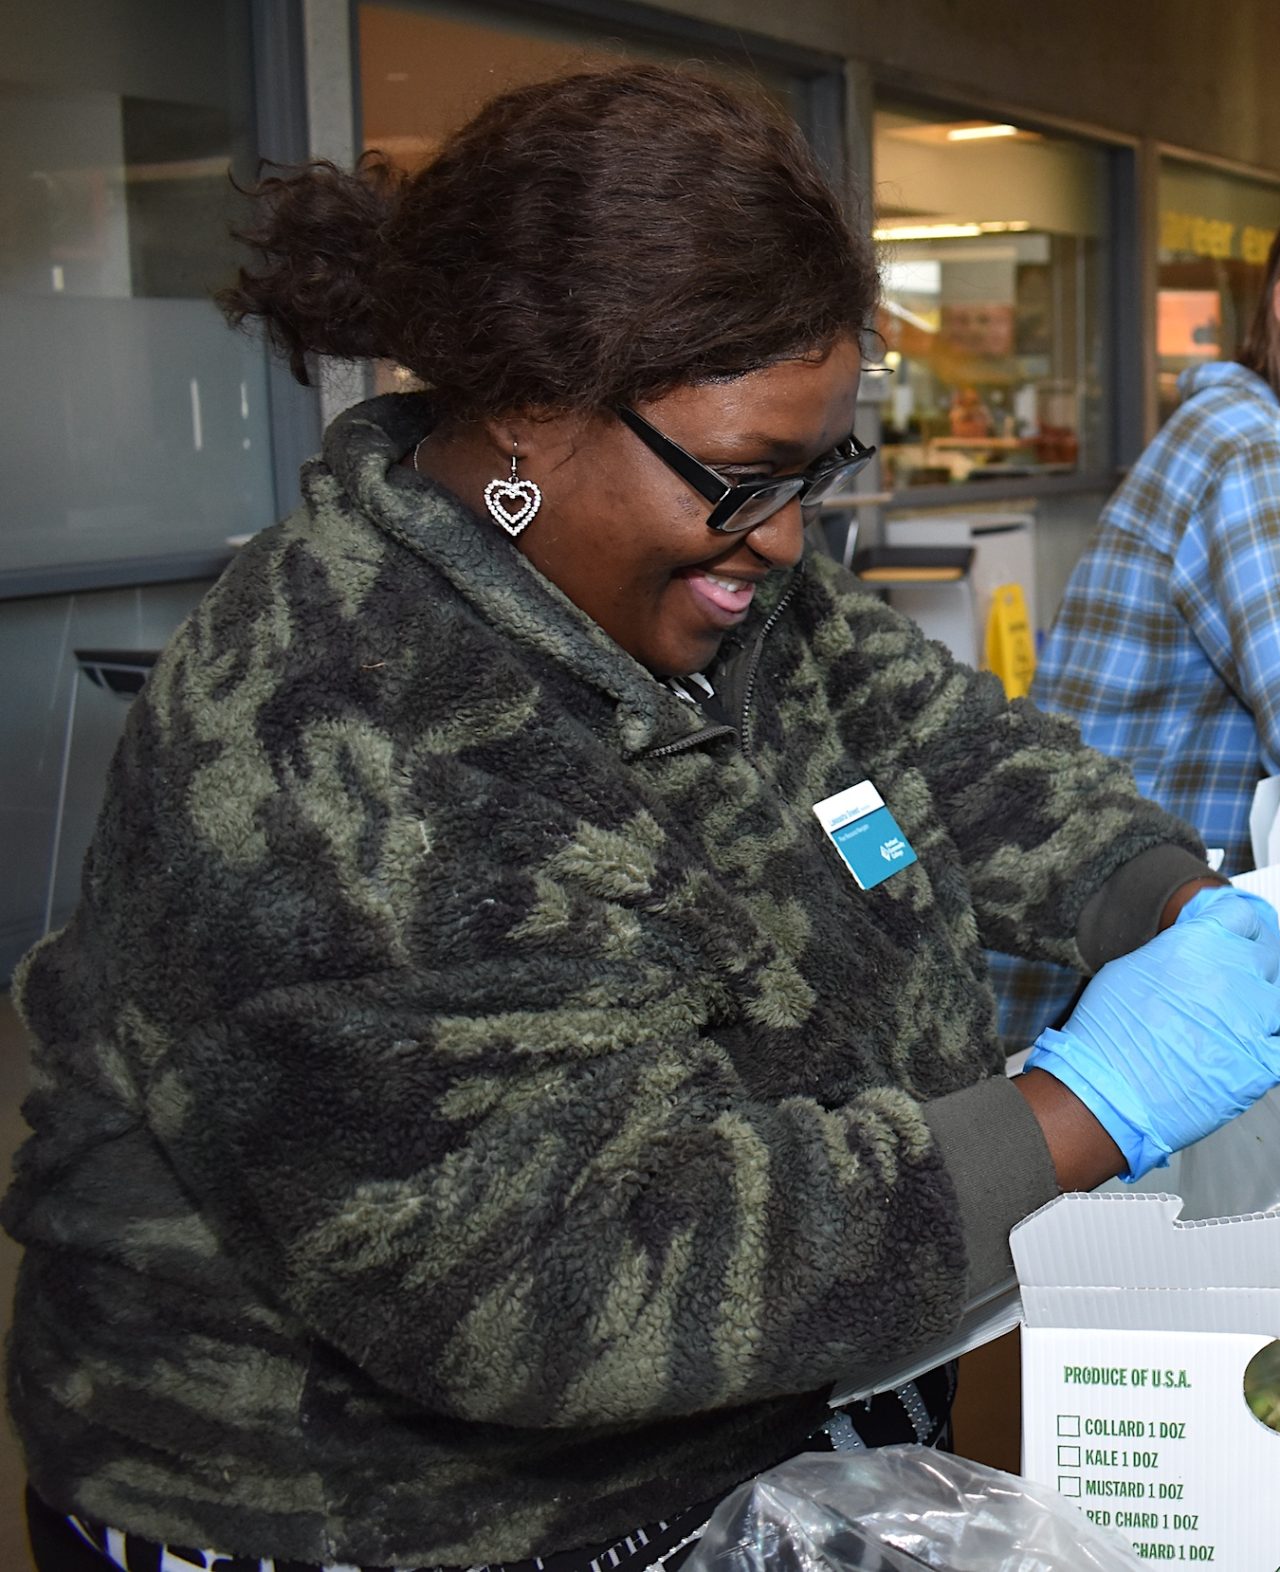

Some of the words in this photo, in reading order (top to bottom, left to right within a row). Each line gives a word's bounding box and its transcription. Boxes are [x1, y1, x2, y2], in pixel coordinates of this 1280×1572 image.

[1064, 1366, 1127, 1386] PRODUCE
[1131, 1368, 1148, 1386] OF
[1151, 1369, 1192, 1389] U.S.A.
[1085, 1418, 1145, 1437] COLLARD
[1148, 1422, 1156, 1438] 1
[1159, 1422, 1186, 1439] DOZ
[1085, 1449, 1118, 1466] KALE
[1122, 1451, 1129, 1467] 1
[1133, 1452, 1159, 1468] DOZ
[1086, 1480, 1145, 1498] MUSTARD
[1148, 1483, 1156, 1499] 1
[1159, 1483, 1184, 1500] DOZ
[1086, 1509, 1111, 1526] RED
[1115, 1511, 1158, 1529] CHARD
[1162, 1514, 1169, 1530] 1
[1173, 1514, 1199, 1531] DOZ
[1178, 1544, 1186, 1561] 1
[1189, 1545, 1215, 1562] DOZ
